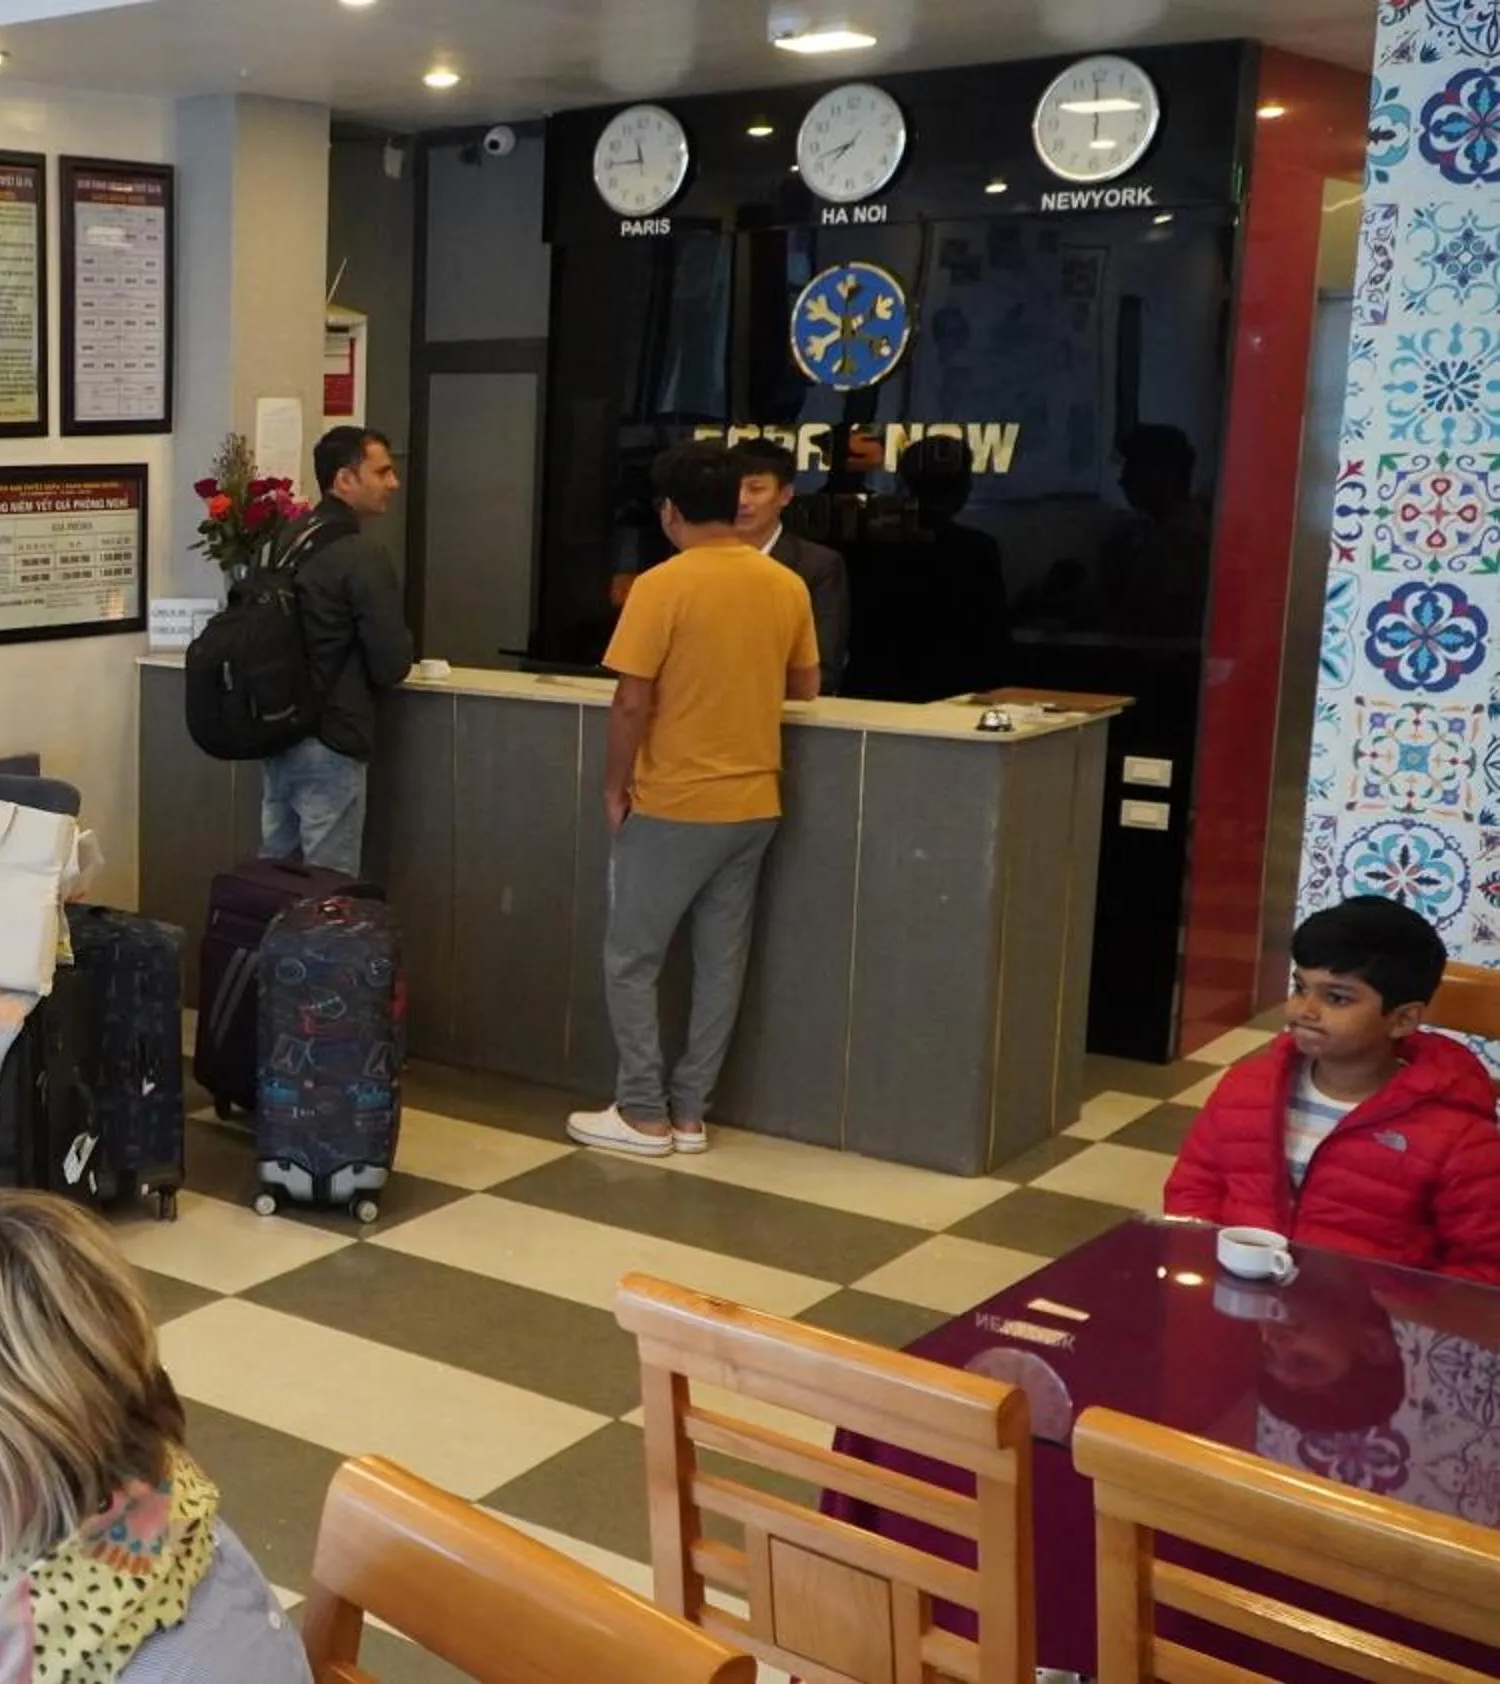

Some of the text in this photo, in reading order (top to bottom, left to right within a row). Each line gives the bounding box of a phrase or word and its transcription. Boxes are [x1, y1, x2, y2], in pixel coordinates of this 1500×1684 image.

[1041, 187, 1155, 211] NEWYORK
[821, 205, 887, 225] HA NOI
[621, 218, 671, 236] PARIS
